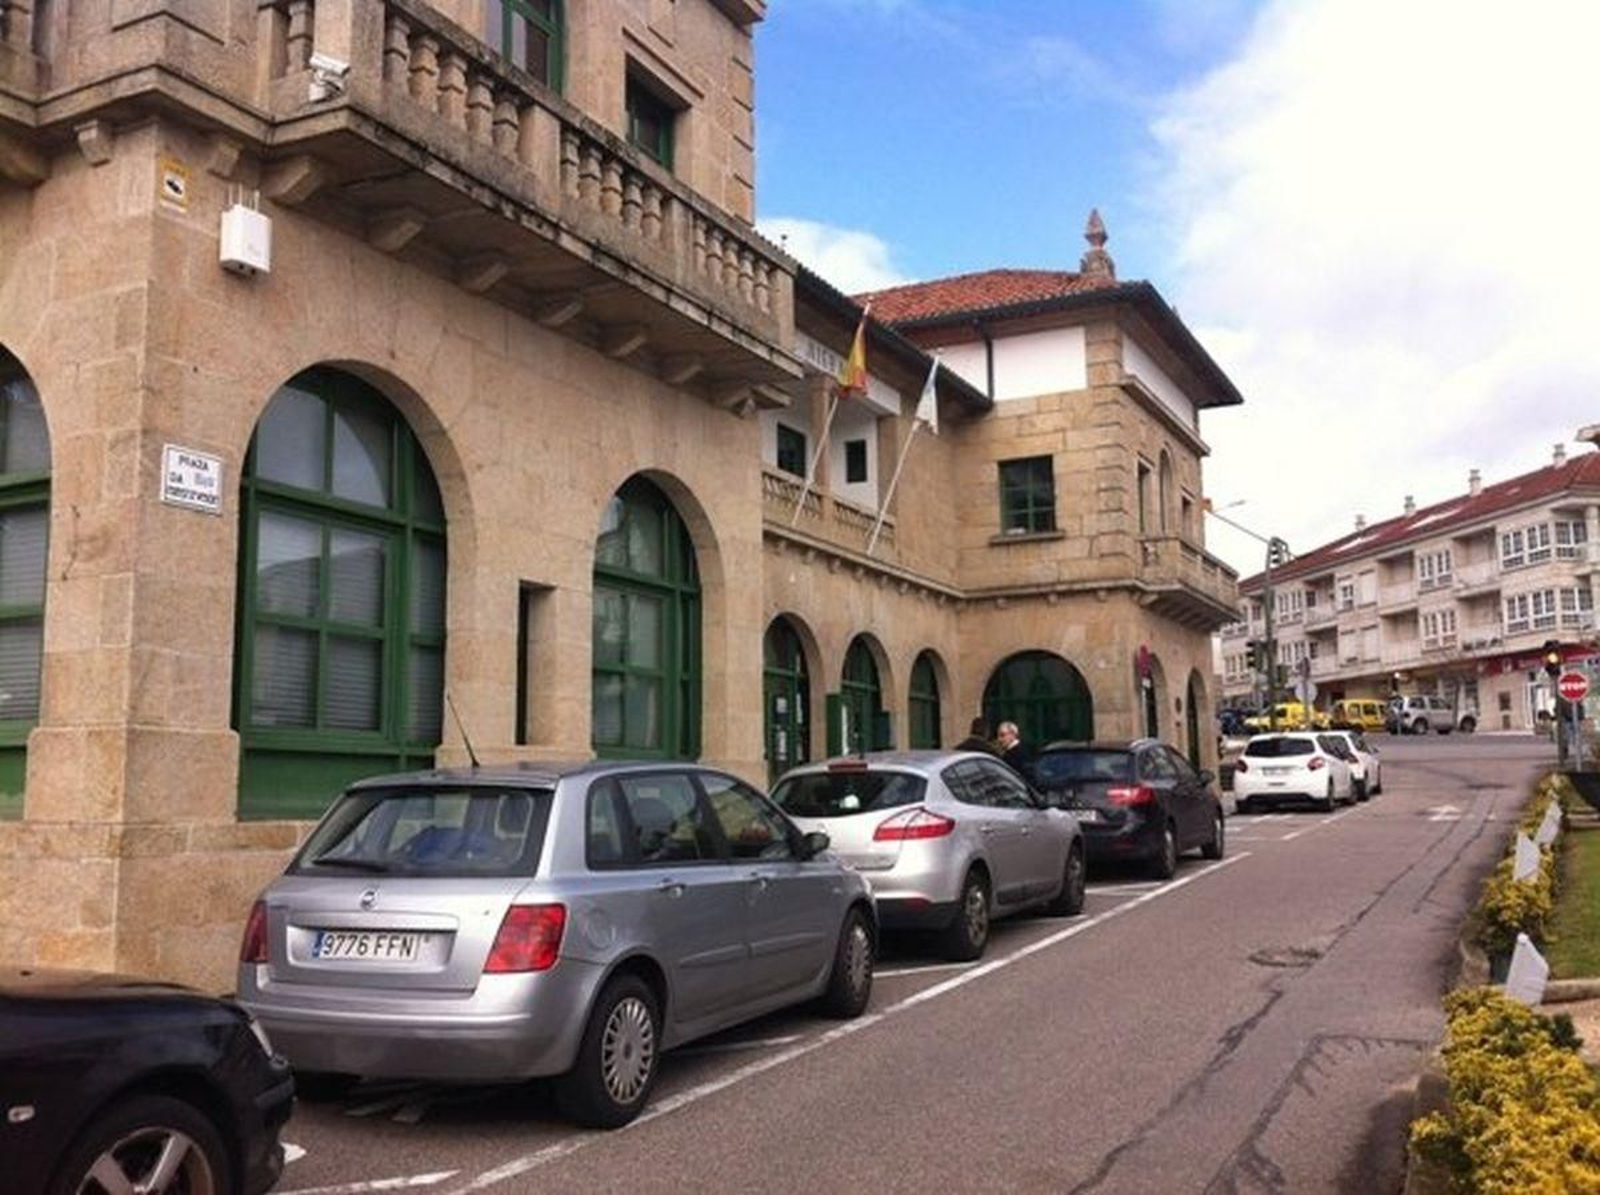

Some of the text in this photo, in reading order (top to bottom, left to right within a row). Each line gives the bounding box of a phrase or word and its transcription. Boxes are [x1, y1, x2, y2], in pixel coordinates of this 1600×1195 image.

[1559, 682, 1587, 691] STOP
[323, 934, 414, 957] 9776 FFN
